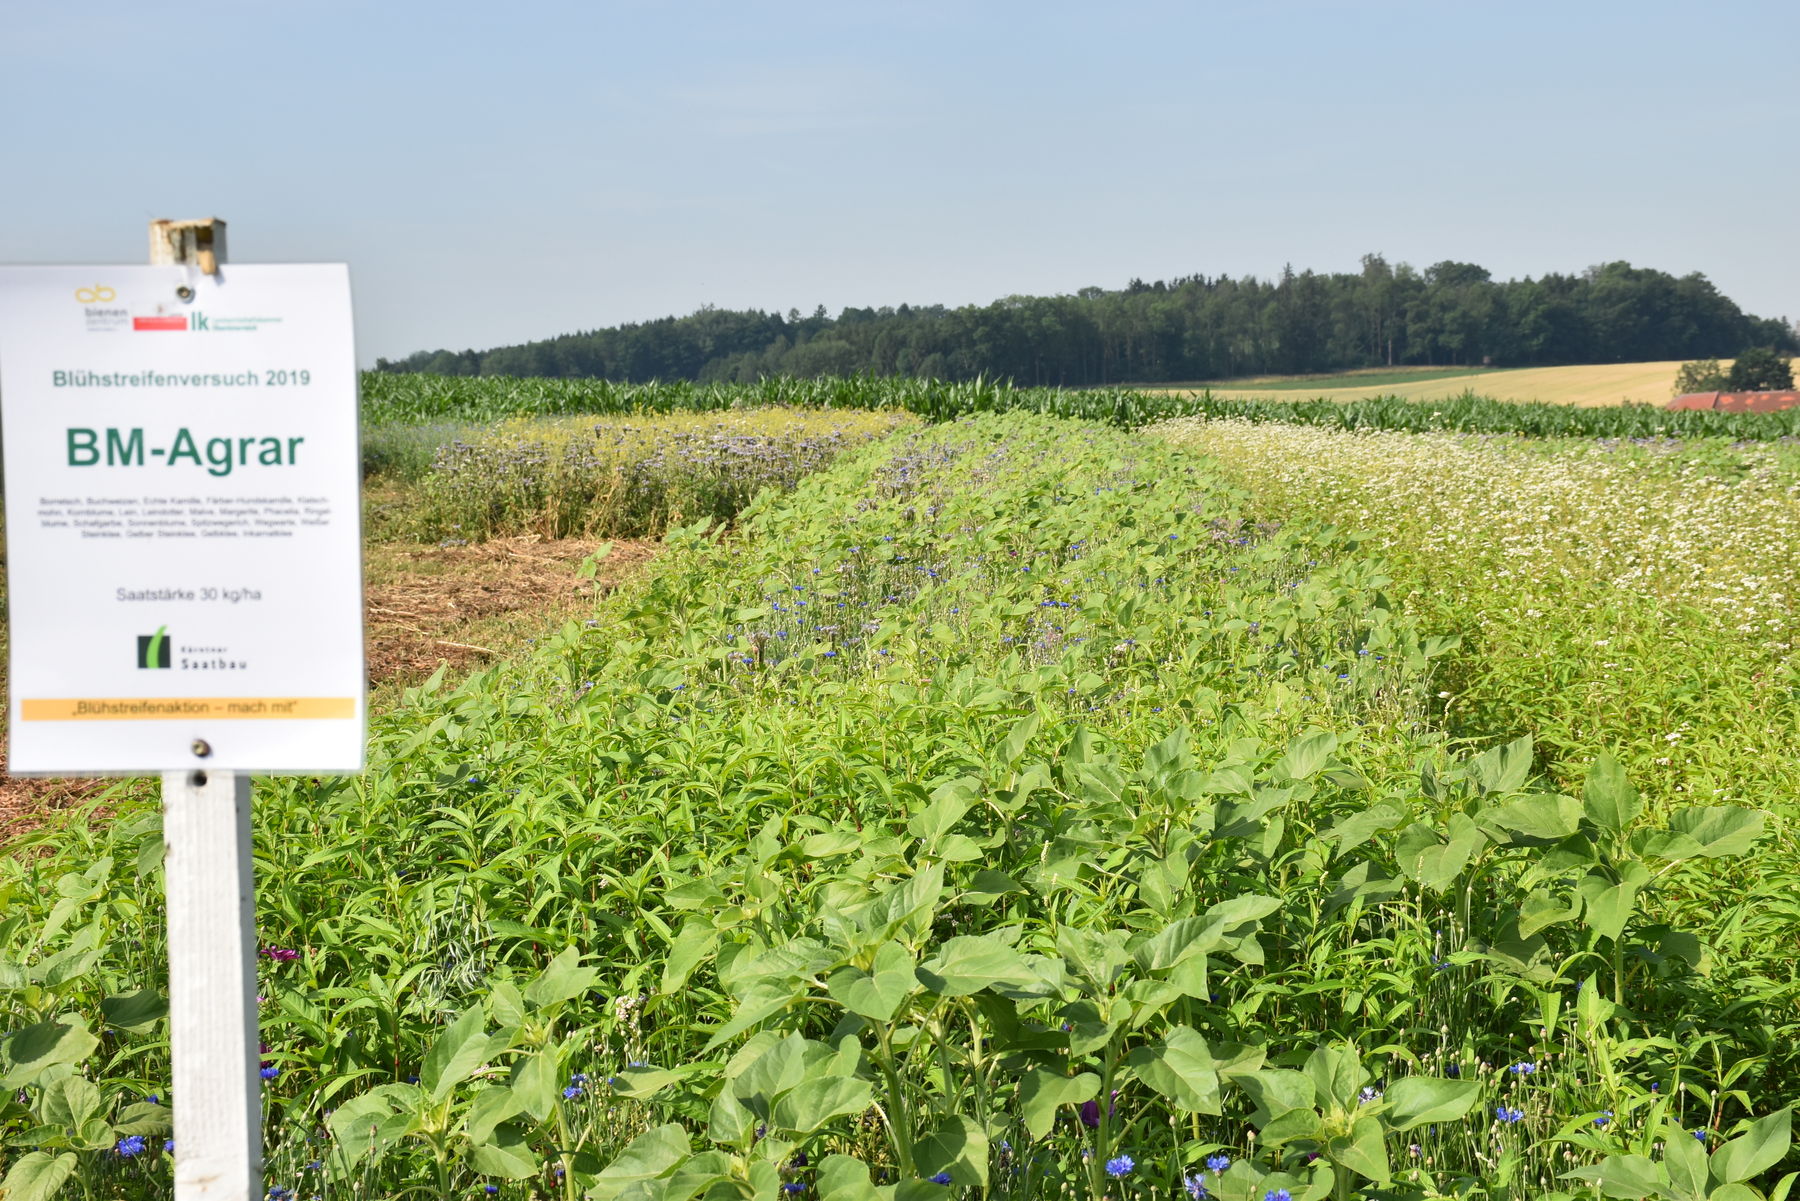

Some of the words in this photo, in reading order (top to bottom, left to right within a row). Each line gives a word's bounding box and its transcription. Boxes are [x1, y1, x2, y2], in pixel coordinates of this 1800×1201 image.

[85, 307, 128, 317] bienen
[53, 370, 259, 387] Blühstreifenversuch
[266, 370, 310, 386] 2019
[67, 428, 304, 476] BM-Agrar
[116, 588, 195, 602] Saatstärke
[200, 588, 218, 601] 30
[222, 587, 262, 604] kg/ha
[181, 658, 247, 670] Saatbau
[227, 700, 267, 713] mach
